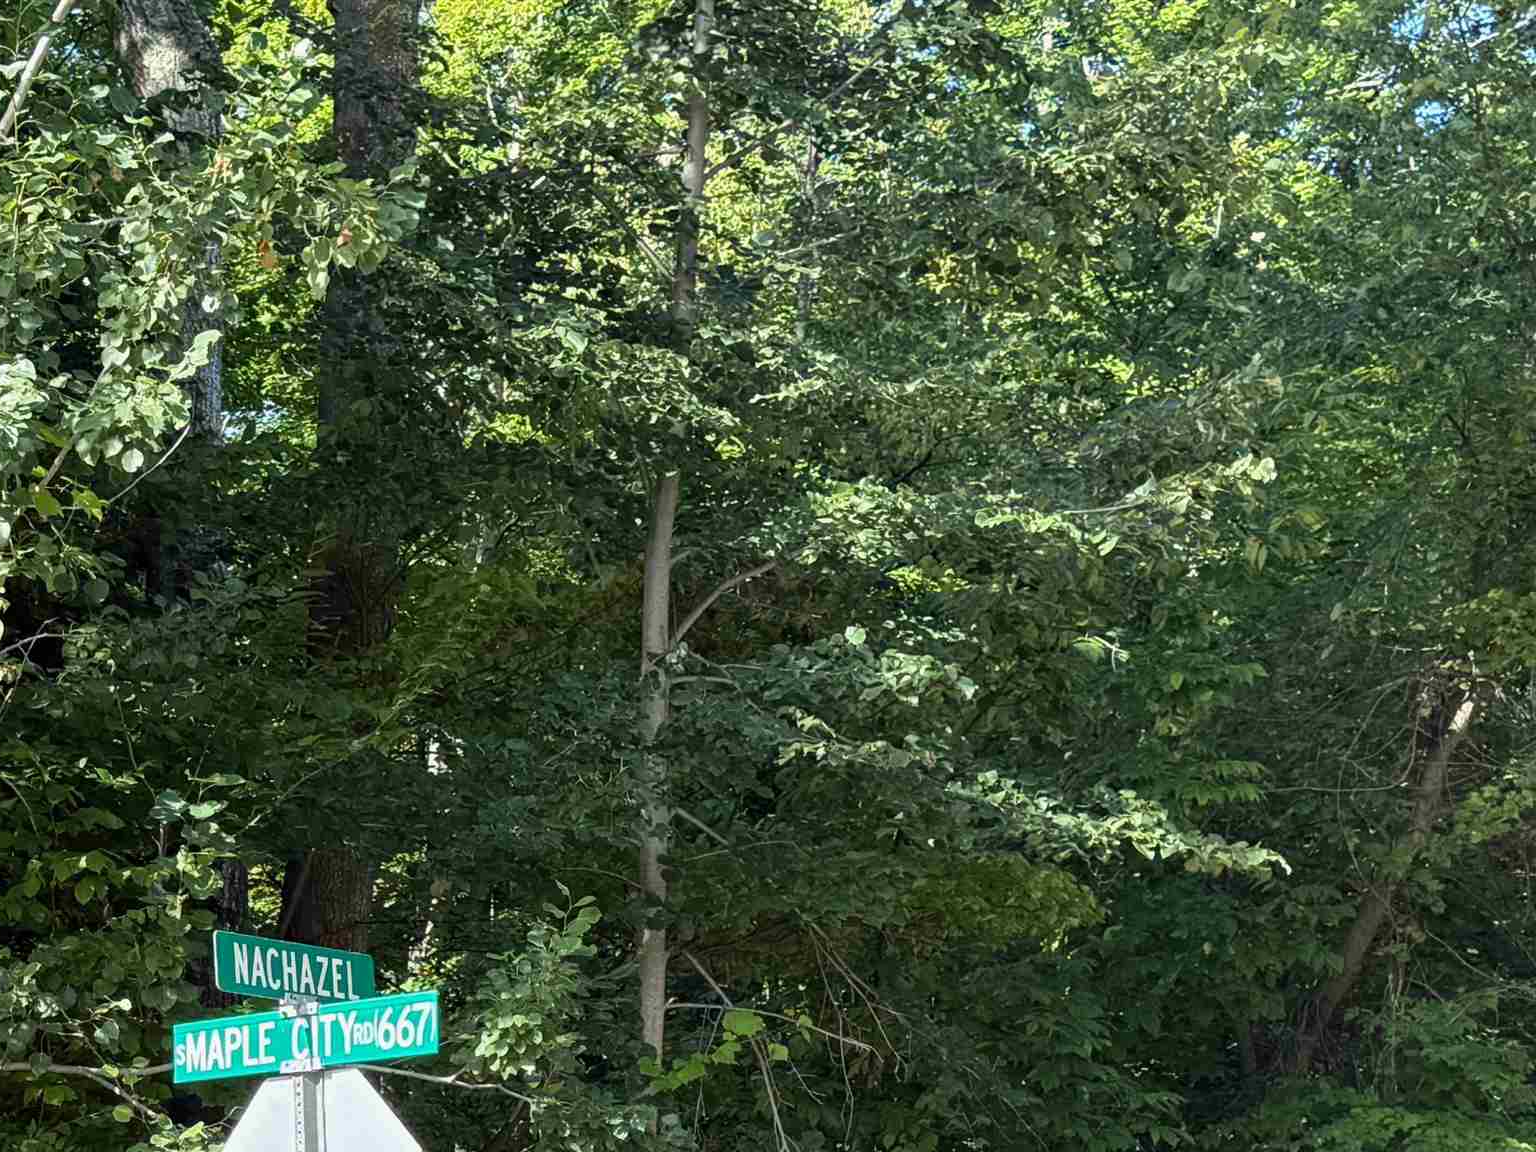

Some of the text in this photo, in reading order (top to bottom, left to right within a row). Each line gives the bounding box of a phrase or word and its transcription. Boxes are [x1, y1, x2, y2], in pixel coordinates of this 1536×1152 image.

[233, 942, 360, 1001] NACHAZEL
[175, 1043, 186, 1067] S
[185, 1020, 276, 1073] MAPLE
[291, 1010, 358, 1060] CITY
[353, 1020, 374, 1046] RD
